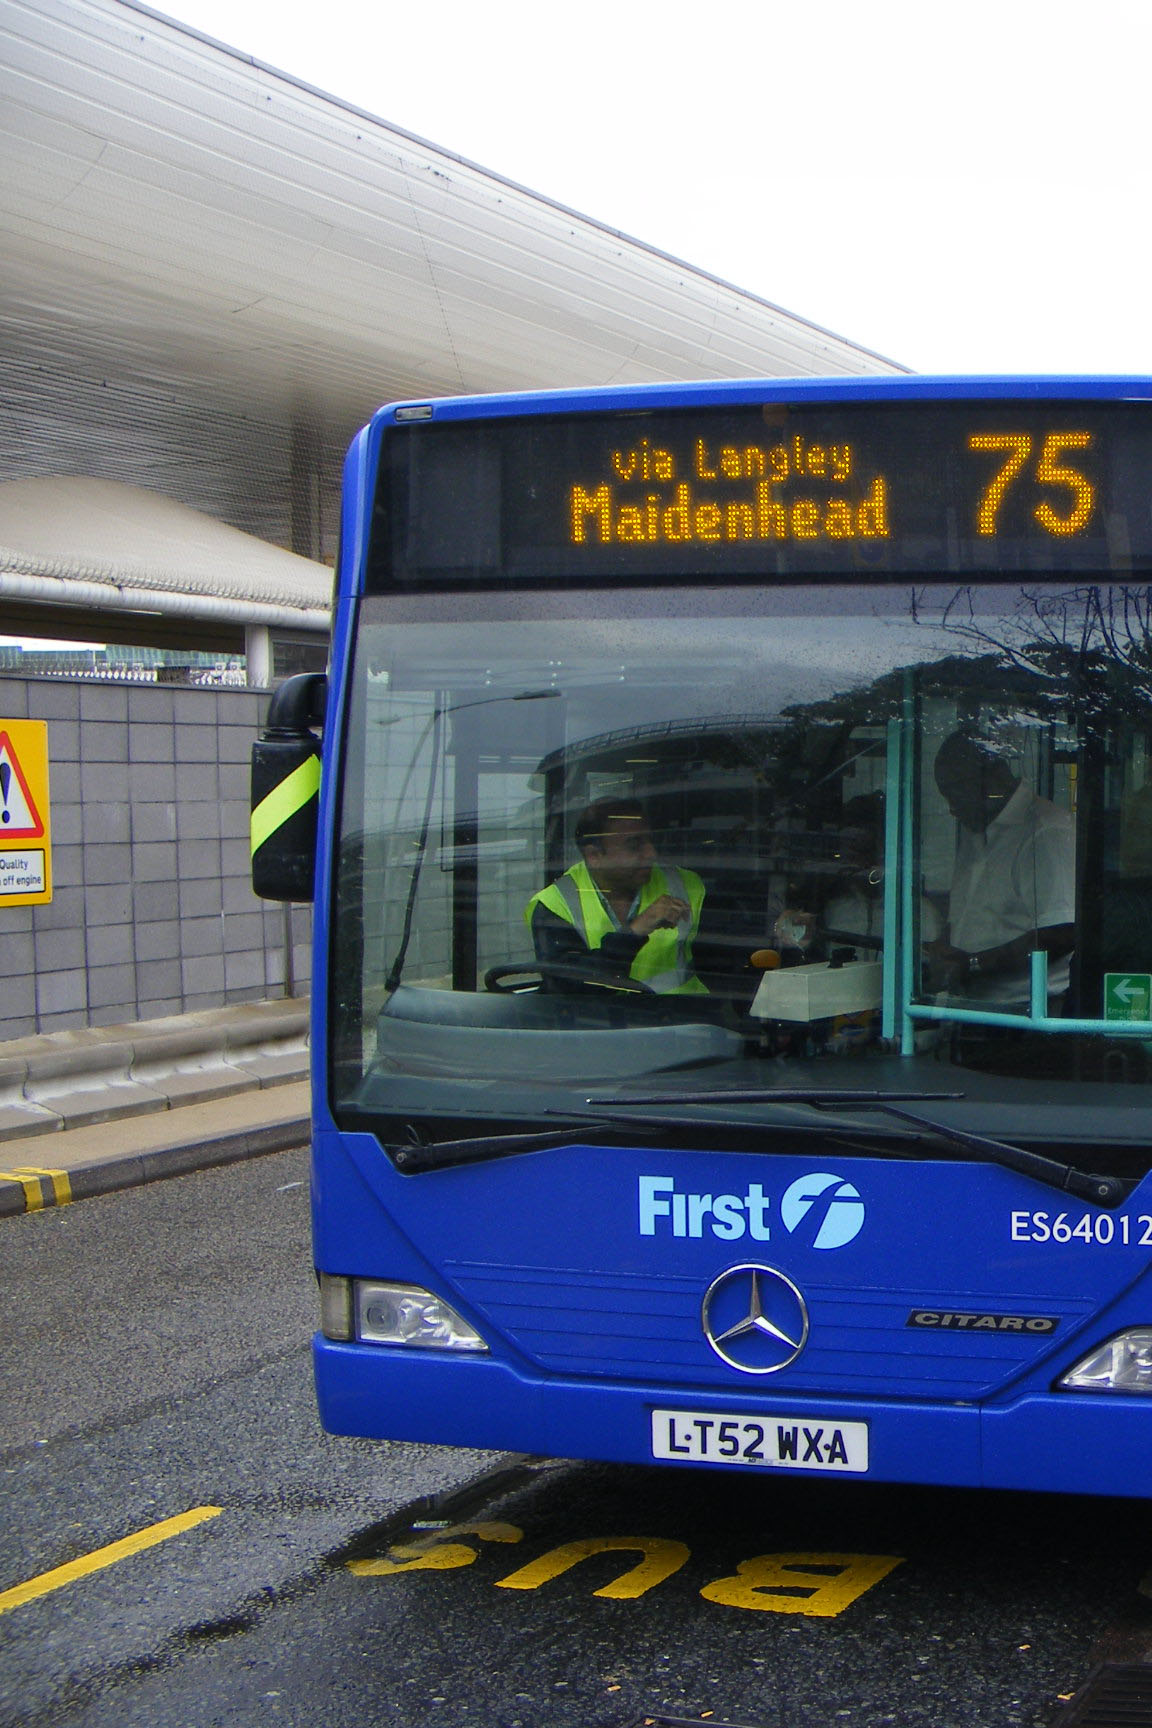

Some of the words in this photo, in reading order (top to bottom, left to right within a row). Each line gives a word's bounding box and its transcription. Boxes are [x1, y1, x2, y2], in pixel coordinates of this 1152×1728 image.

[612, 438, 673, 481] via
[698, 436, 851, 482] Langley
[969, 431, 1095, 536] 75
[570, 474, 889, 543] Maidenhead
[0, 859, 28, 871] Quality
[3, 874, 14, 885] off
[16, 873, 42, 887] engine
[638, 1176, 770, 1241] First
[914, 1312, 1053, 1331] CITARO
[668, 1417, 765, 1458] LT52
[777, 1425, 849, 1465] WXA
[345, 1521, 906, 1617] BUS
